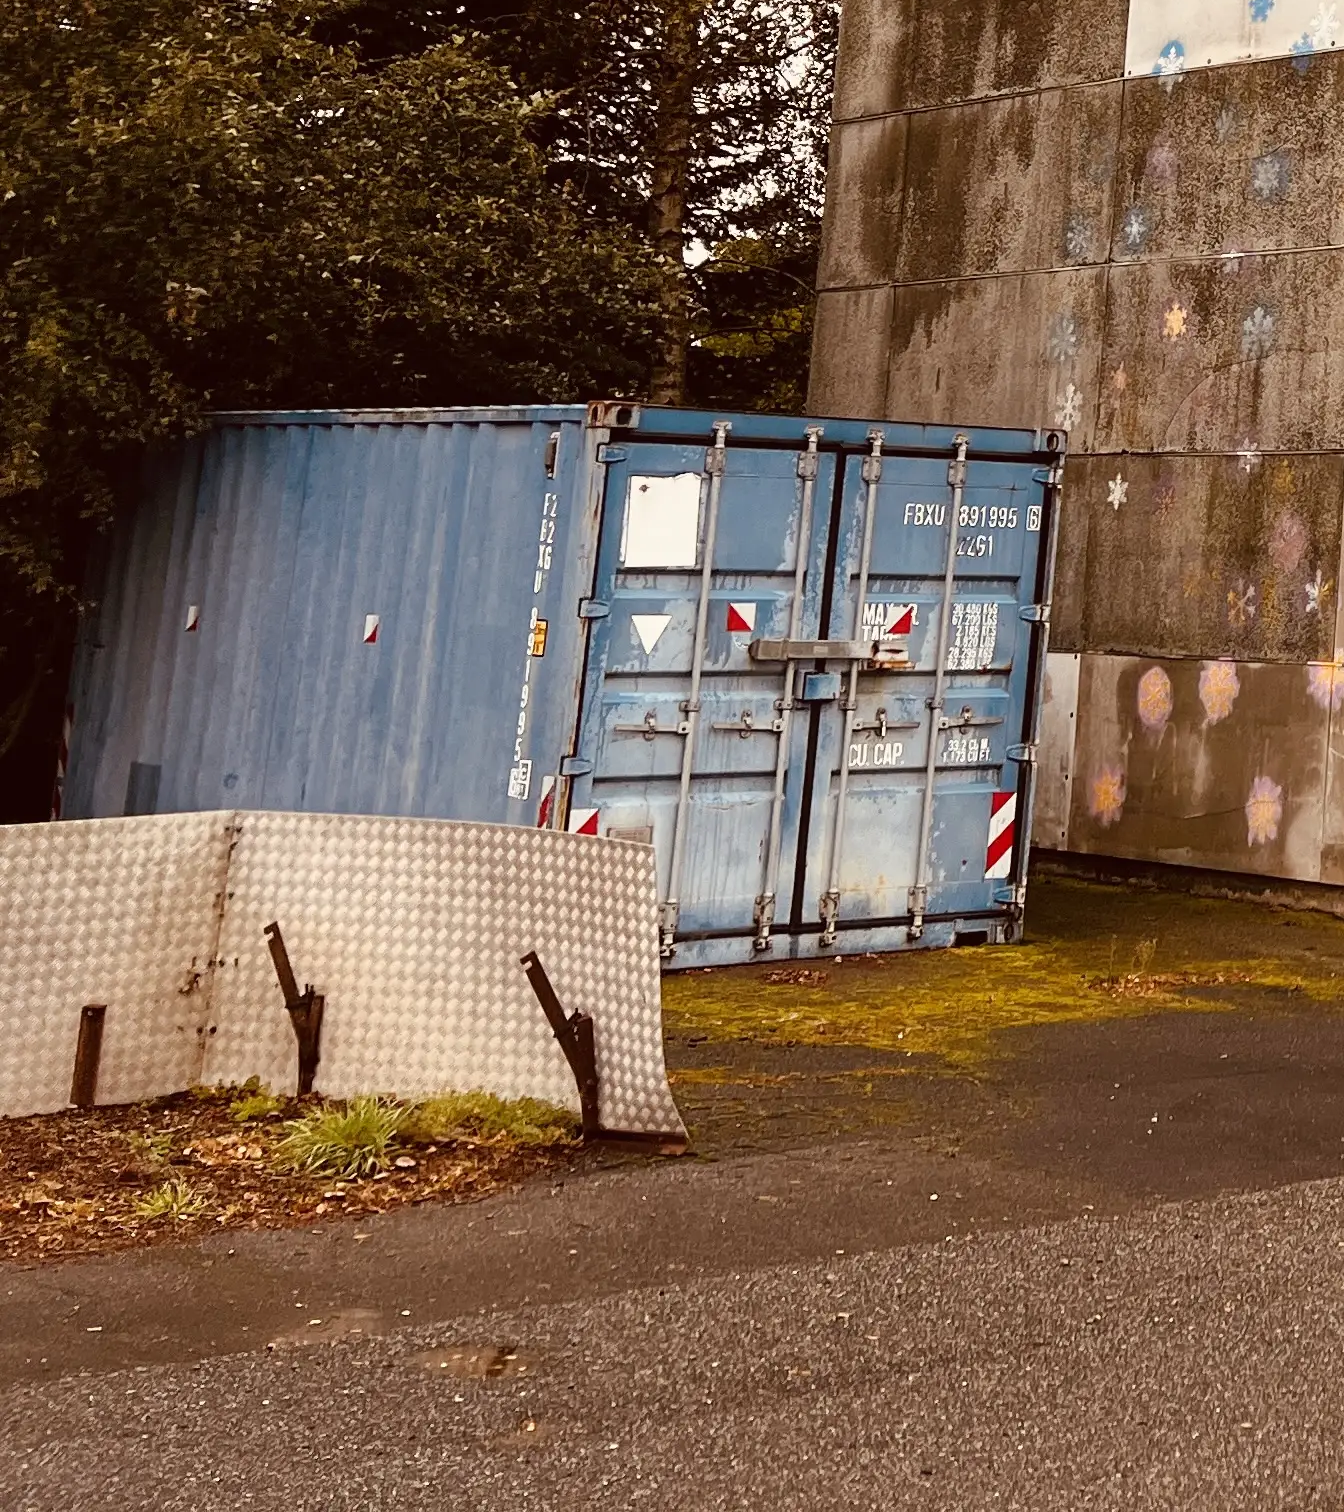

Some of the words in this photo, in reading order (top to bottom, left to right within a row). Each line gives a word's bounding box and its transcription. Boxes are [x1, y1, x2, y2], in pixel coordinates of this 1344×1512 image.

[903, 502, 946, 526] FBXU
[958, 505, 1019, 529] 891995
[1027, 507, 1040, 529] 6
[847, 743, 870, 767] CU.
[873, 742, 905, 766] CAP.
